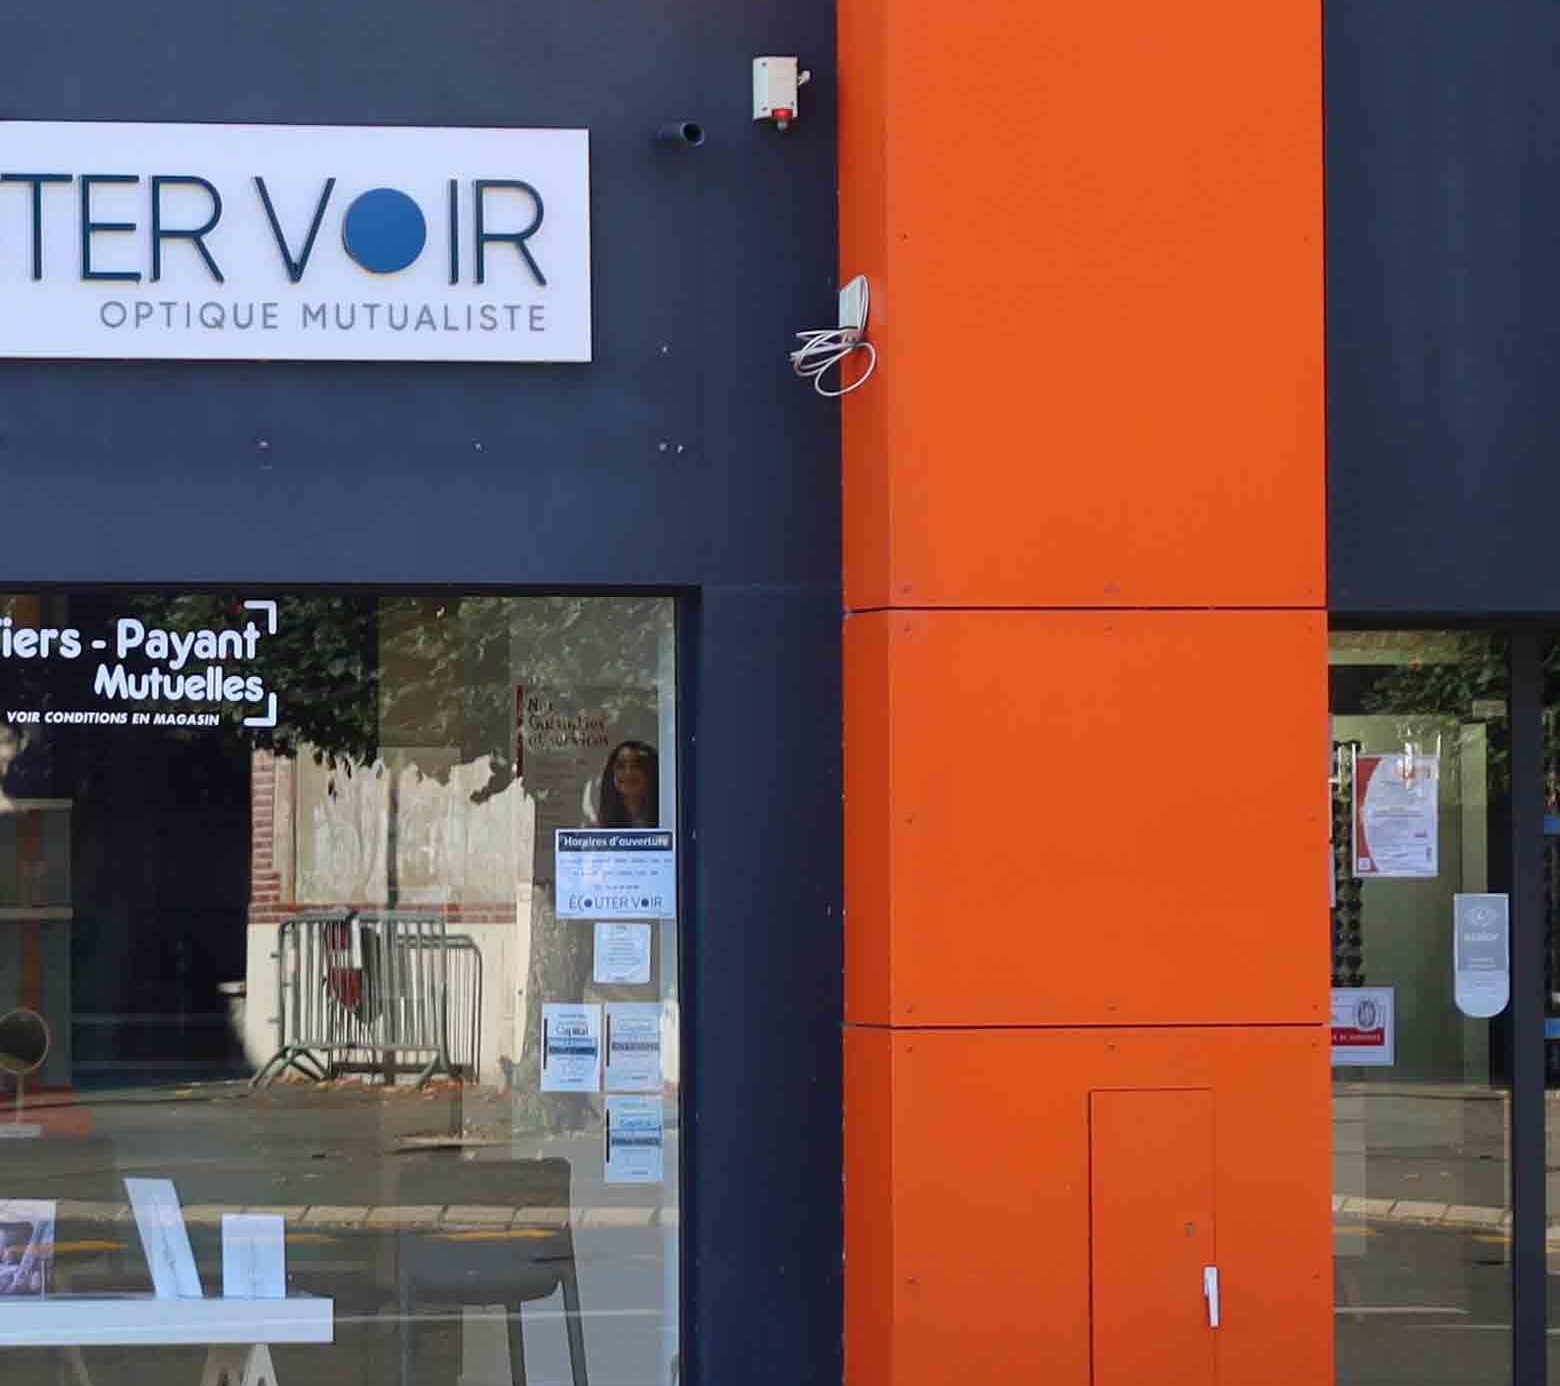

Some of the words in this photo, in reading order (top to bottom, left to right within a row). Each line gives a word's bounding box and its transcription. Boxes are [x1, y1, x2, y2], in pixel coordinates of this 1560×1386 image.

[254, 177, 547, 287] VOIR
[99, 300, 281, 331] OPTIQUE
[300, 302, 548, 334] MUTUALISTE
[116, 618, 261, 670] Payant
[93, 663, 265, 702] Mutuelles
[6, 710, 41, 724] VOIR
[44, 711, 128, 725] CONDITIONS
[131, 712, 151, 725] EN
[153, 712, 221, 726] MAGASIN
[562, 836, 607, 847] Horaires
[609, 835, 669, 848] d'ouverture
